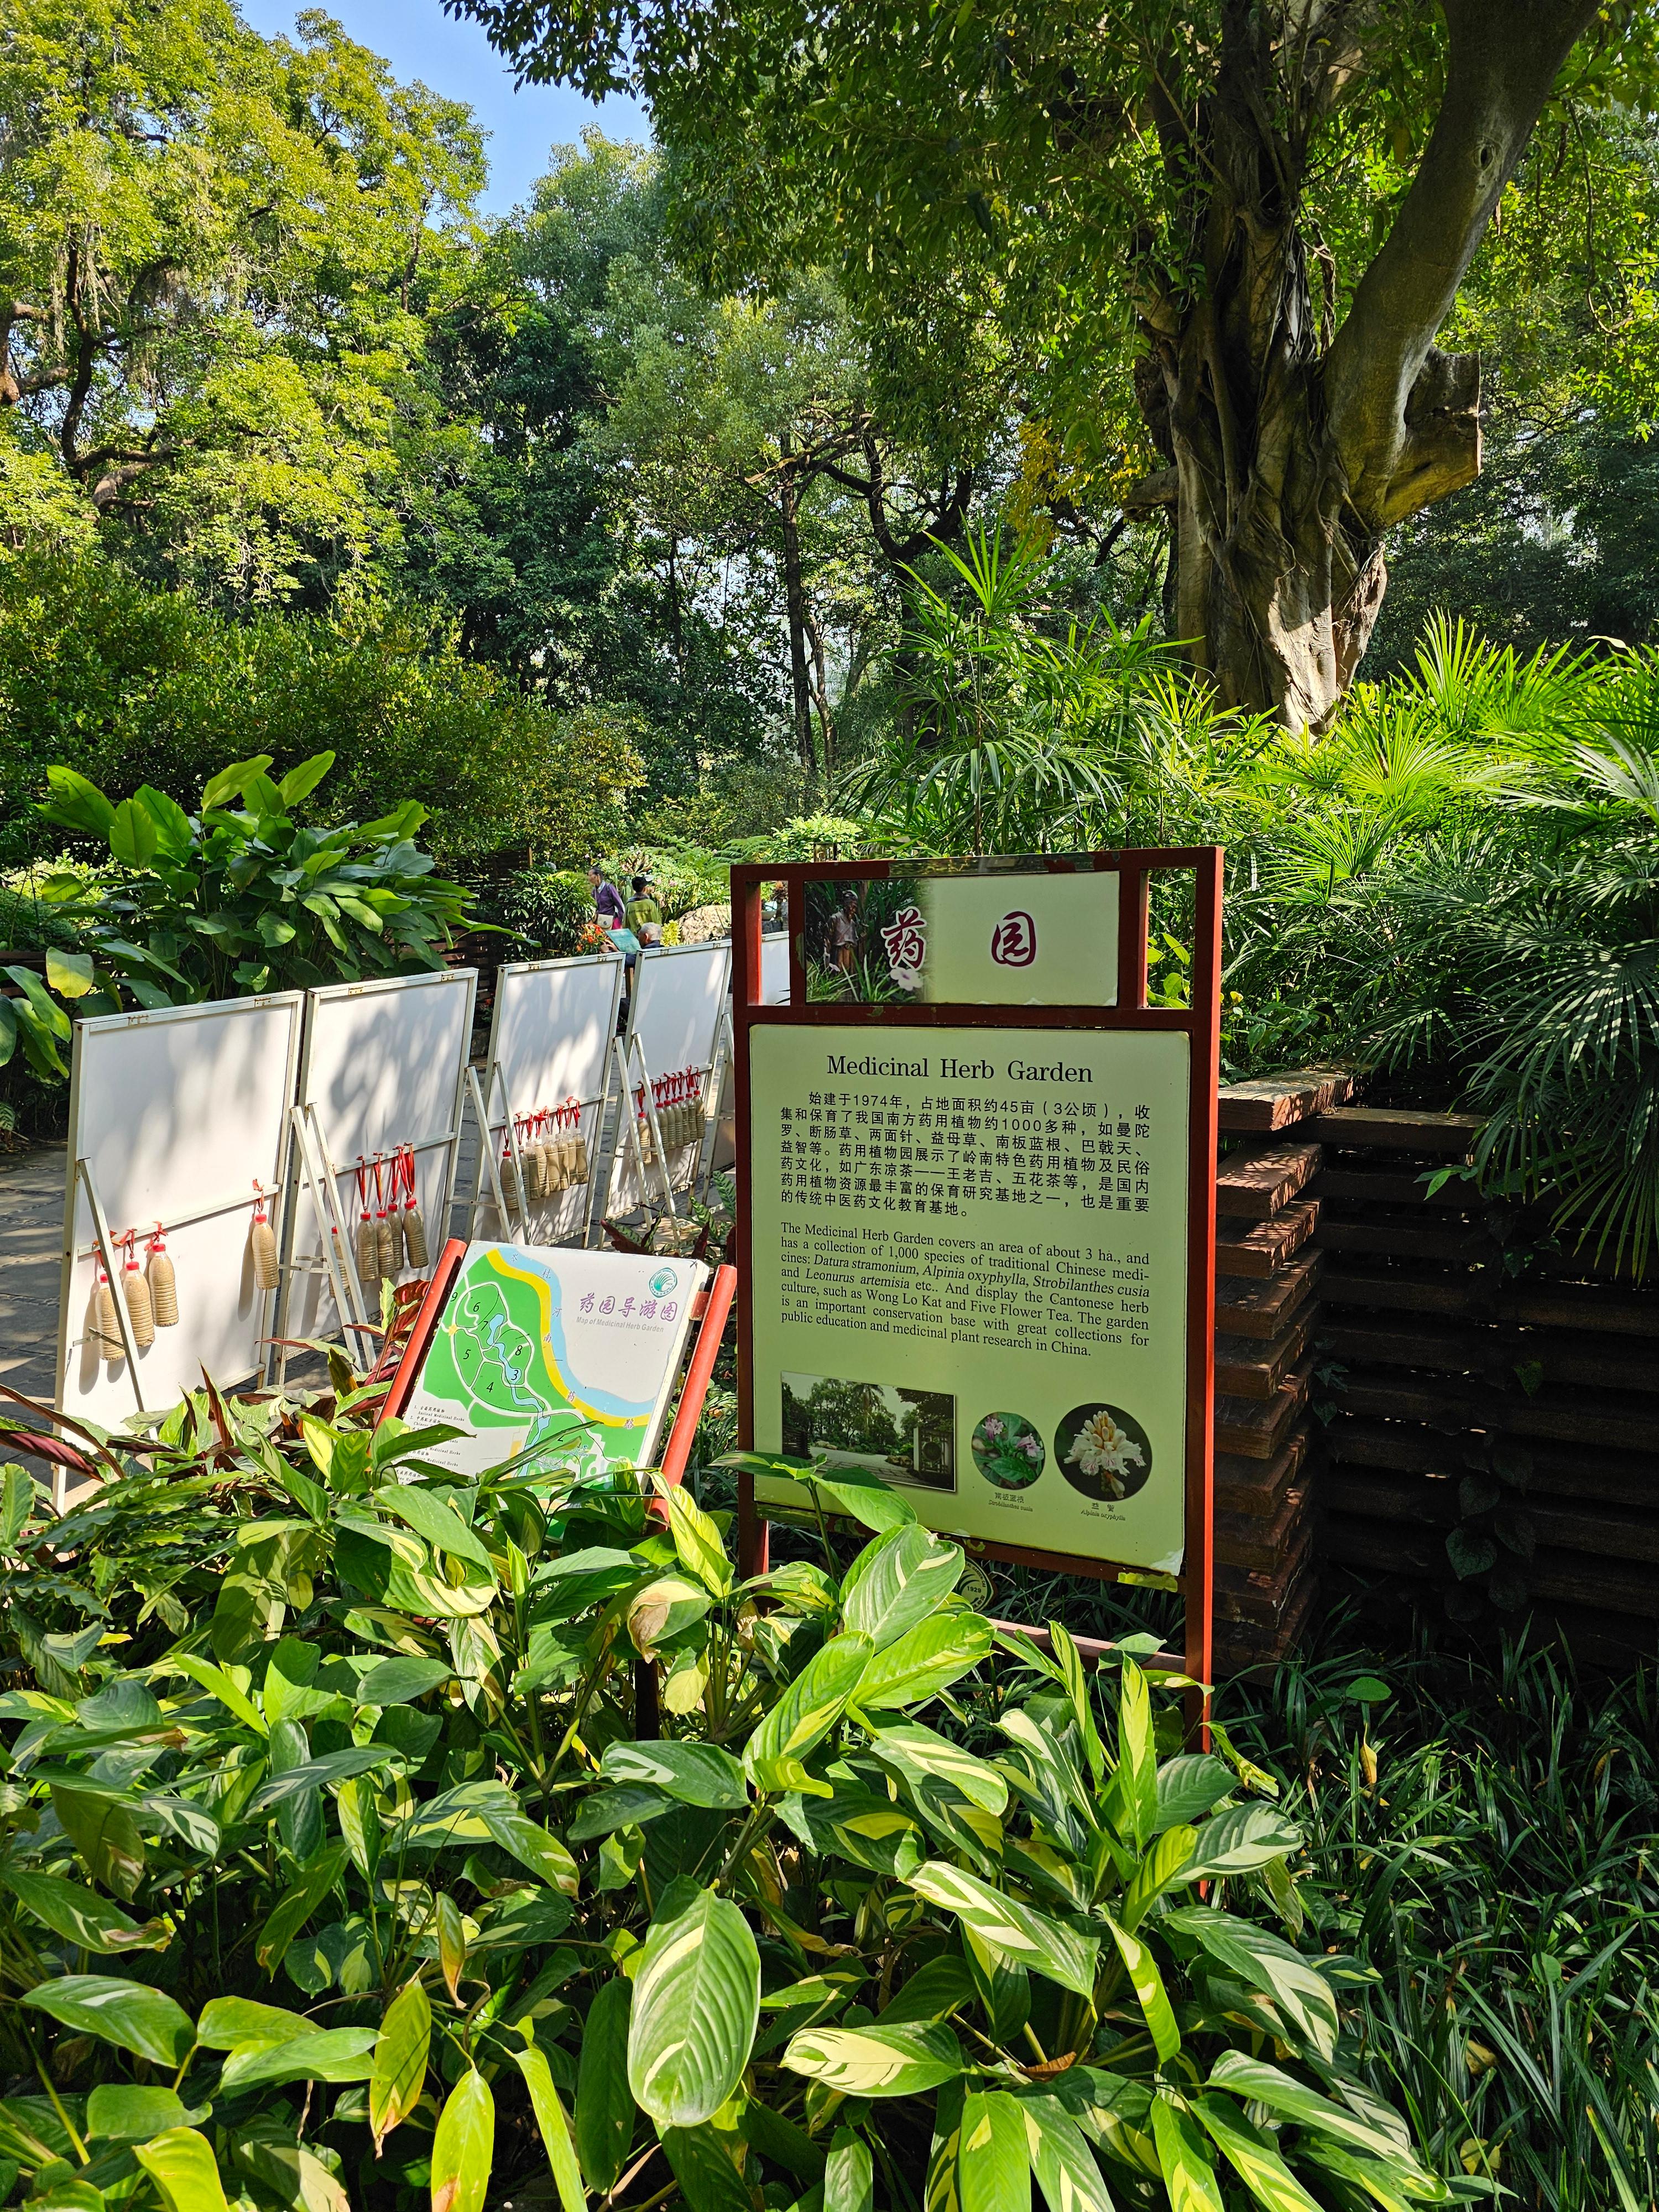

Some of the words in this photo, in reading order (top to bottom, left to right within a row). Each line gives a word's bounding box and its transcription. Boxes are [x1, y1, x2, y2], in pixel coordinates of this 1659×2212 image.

[827, 1055, 930, 1077] Medicinal
[940, 1058, 994, 1079] Herb
[1008, 1060, 1093, 1083] Garden
[781, 1222, 801, 1234] The
[805, 1223, 858, 1239] Medicinal
[862, 1228, 889, 1241] Herb
[893, 1231, 934, 1246] Garden
[938, 1238, 975, 1249] covers
[980, 1241, 994, 1251] an
[999, 1243, 1024, 1254] area
[1029, 1243, 1043, 1255] of
[1046, 1245, 1081, 1259] about
[1085, 1248, 1092, 1260] 3
[1126, 1253, 1150, 1265] and
[781, 1236, 798, 1249] has
[803, 1241, 809, 1249] a
[814, 1240, 866, 1255] collection
[871, 1244, 884, 1256] of
[924, 1251, 965, 1264] species
[971, 1254, 985, 1266] of
[988, 1256, 1050, 1272] traditional
[1056, 1261, 1106, 1277] Chinese
[781, 1251, 810, 1264] cines:
[813, 1254, 849, 1268] Datura
[852, 1259, 919, 1277] stramonium,
[922, 1265, 964, 1280] Alpinia
[967, 1271, 1029, 1288] oxyphylla,
[1032, 1275, 1114, 1295] Strobilanthes
[1117, 1285, 1150, 1298] cusia
[450, 1292, 458, 1302] 9
[781, 1266, 800, 1278] and
[805, 1268, 855, 1284] Leonurus
[860, 1276, 910, 1289] artemisia
[945, 1282, 969, 1295] And
[975, 1285, 1018, 1303] display
[1024, 1290, 1043, 1303] the
[1050, 1292, 1114, 1311] Cantonese
[1121, 1299, 1149, 1314] herb
[473, 1302, 481, 1313] 6
[580, 1292, 678, 1322] 药园导游图
[781, 1281, 820, 1297] culture,
[823, 1286, 847, 1297] such
[851, 1290, 862, 1300] as
[865, 1288, 899, 1306] Wong
[902, 1292, 917, 1305] Lo
[921, 1295, 942, 1308] Kat
[946, 1299, 966, 1311] and
[970, 1300, 996, 1314] Five
[1000, 1303, 1043, 1319] Flower
[1046, 1308, 1072, 1322] Tea.
[1077, 1311, 1102, 1325] The
[1105, 1316, 1149, 1331] garden
[481, 1321, 489, 1332] 7
[576, 1316, 588, 1325] Map
[596, 1318, 625, 1328] Medicinal
[625, 1322, 641, 1330] Herb
[641, 1324, 664, 1333] Garden
[781, 1295, 790, 1306] is
[796, 1300, 808, 1308] an
[815, 1298, 866, 1314] important
[873, 1308, 943, 1323] conservation
[950, 1313, 976, 1327] base
[983, 1318, 1009, 1331] with
[1017, 1324, 1047, 1335] great
[1055, 1326, 1122, 1344] collections
[1130, 1333, 1150, 1347] for
[781, 1311, 813, 1323] public
[816, 1314, 867, 1330] education
[870, 1321, 890, 1332] and
[893, 1324, 947, 1339] medicinal
[951, 1329, 980, 1343] plant
[983, 1336, 1032, 1349] research
[1036, 1338, 1047, 1351] in
[1051, 1340, 1091, 1357] China.
[463, 1349, 471, 1360] 5
[515, 1345, 523, 1357] 8
[511, 1370, 519, 1381] 3
[486, 1382, 494, 1393] 4
[1081, 1509, 1100, 1517] Alpinia
